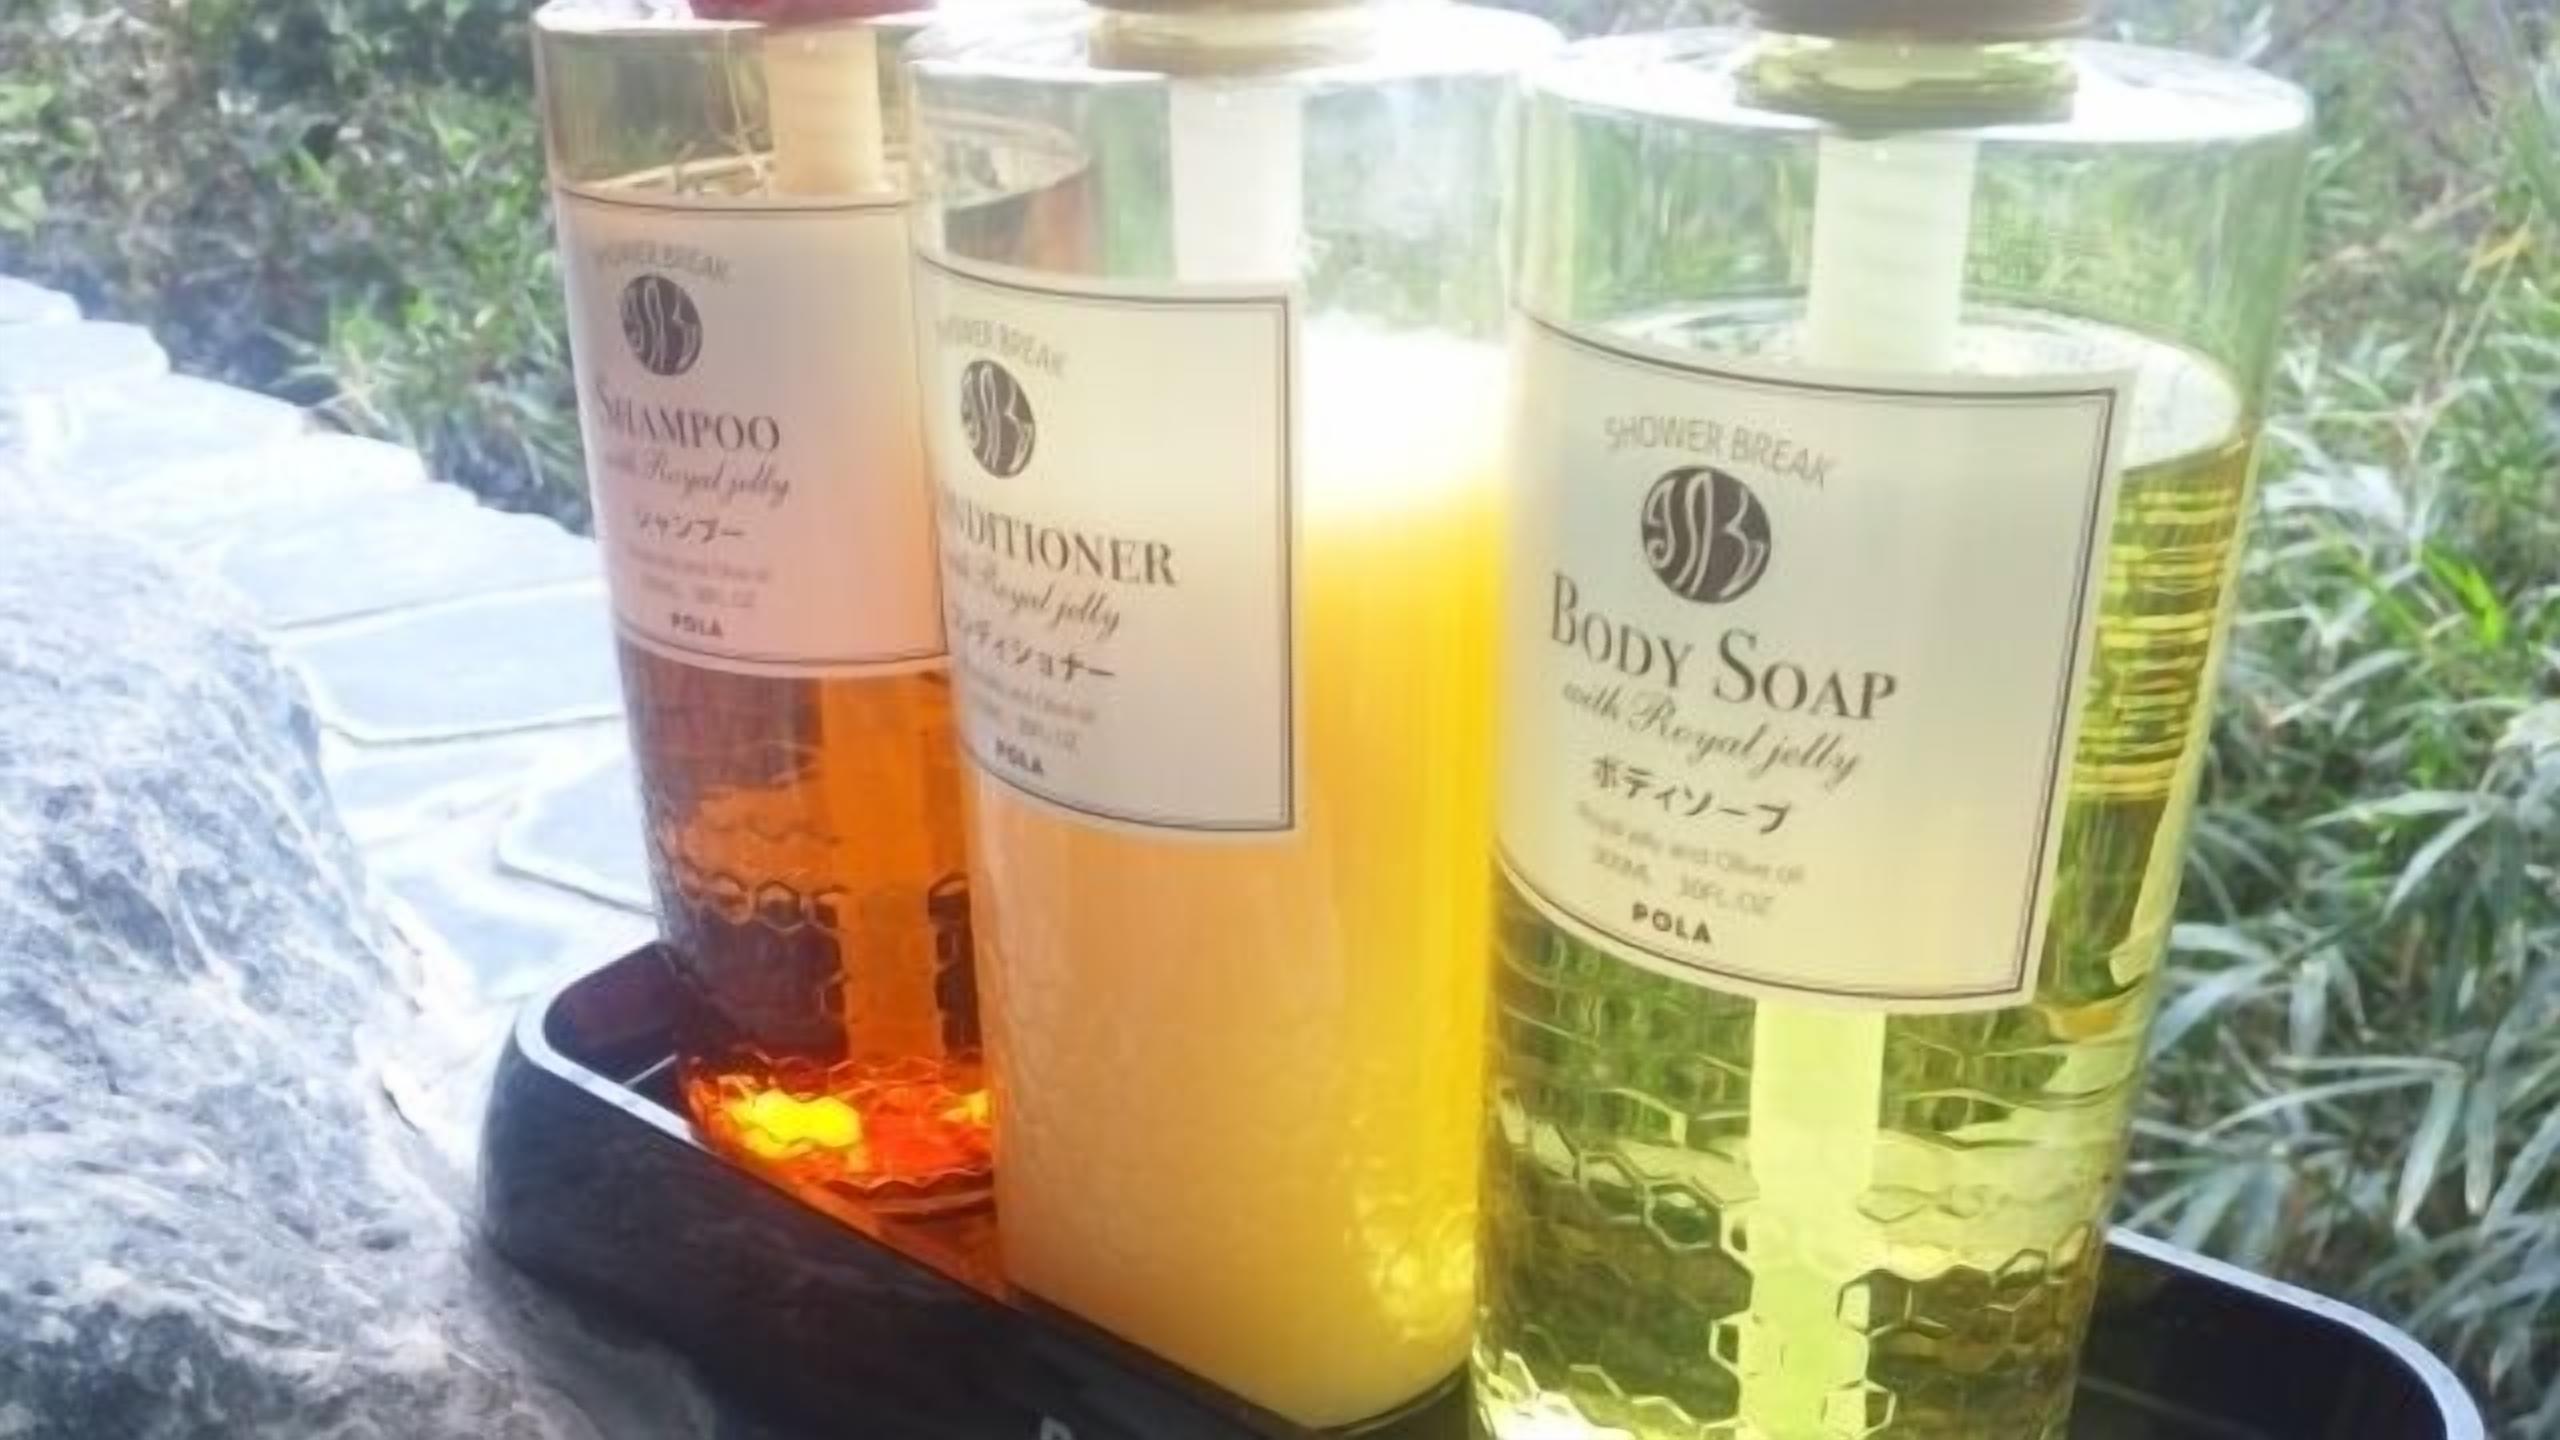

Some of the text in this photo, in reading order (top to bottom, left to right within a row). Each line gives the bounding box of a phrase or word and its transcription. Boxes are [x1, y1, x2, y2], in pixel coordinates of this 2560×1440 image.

[595, 380, 782, 453] SHAMPOO
[1604, 415, 1836, 489] SHOWER BREAK
[669, 611, 725, 639] POLA
[1550, 571, 1899, 721] BODY SOAP
[994, 736, 1047, 778] POLA
[1561, 679, 1865, 793] with Royal jelly
[1631, 901, 1713, 944] POLA
